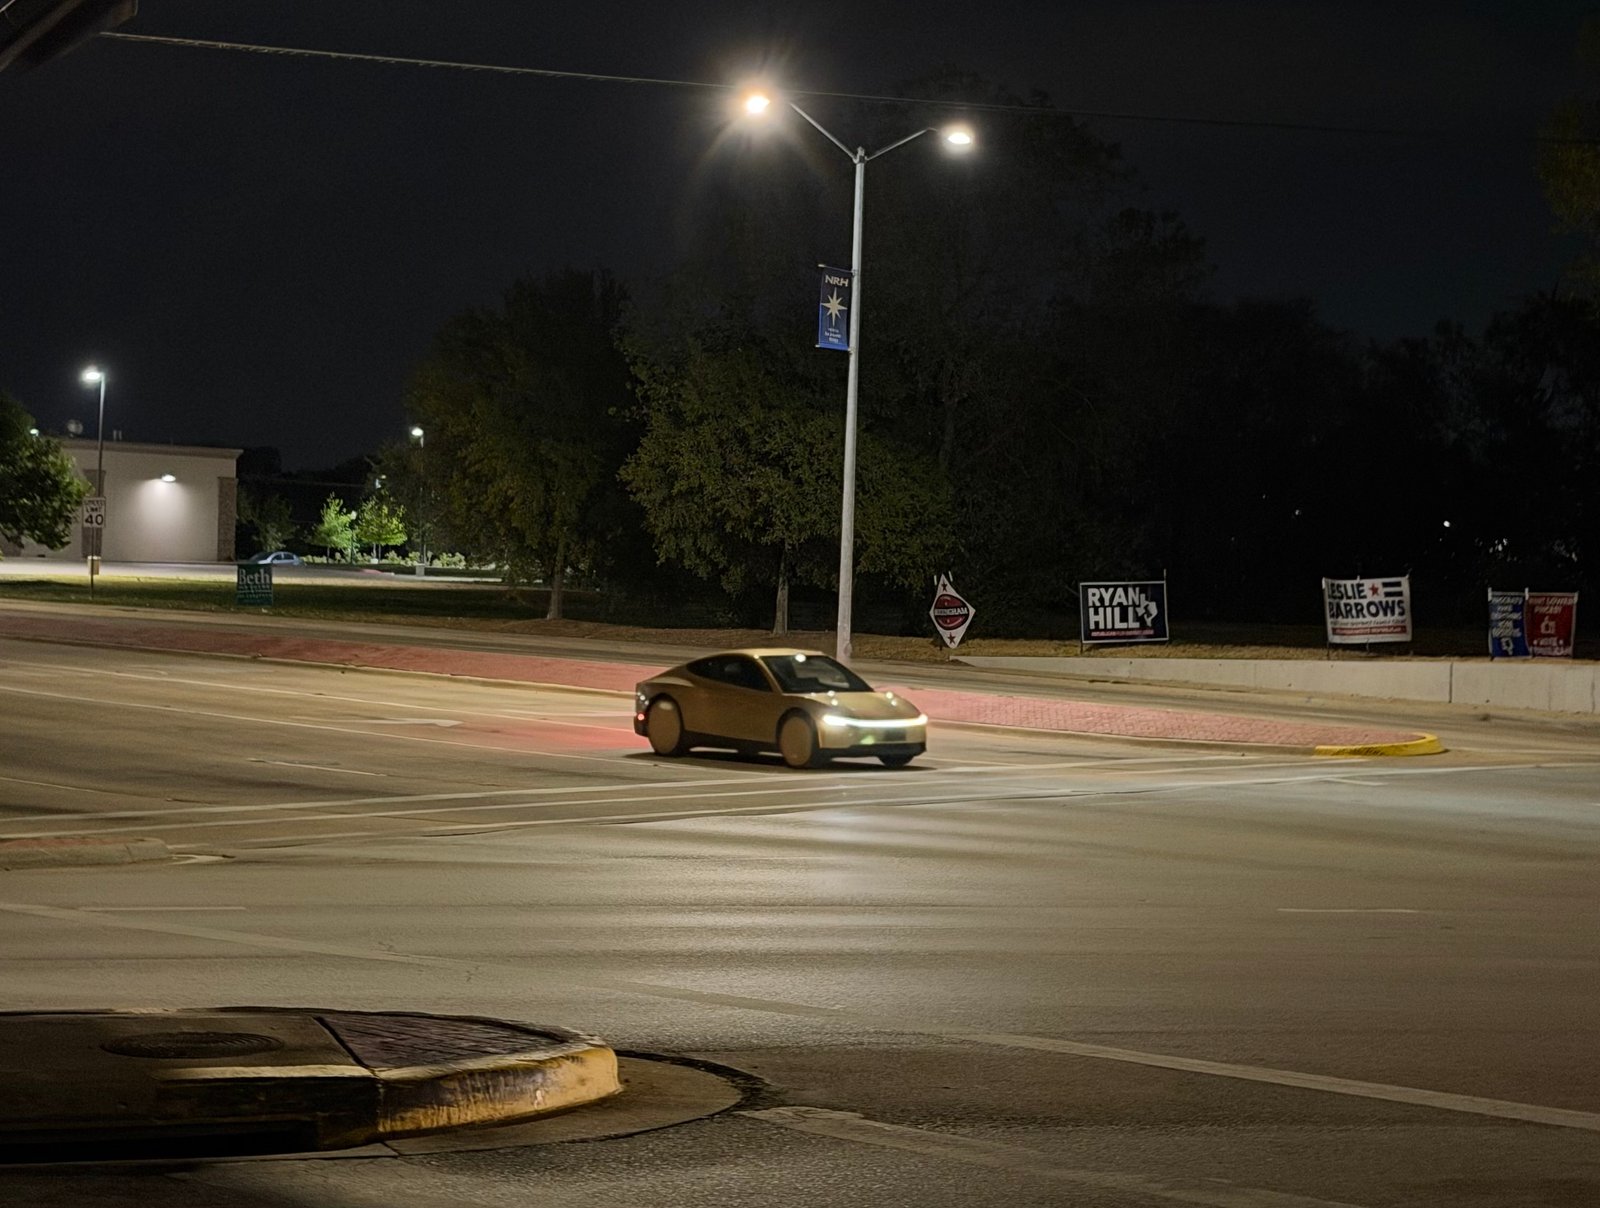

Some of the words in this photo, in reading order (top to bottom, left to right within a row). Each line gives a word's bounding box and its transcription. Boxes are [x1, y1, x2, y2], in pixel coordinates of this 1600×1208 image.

[825, 275, 848, 287] NRH
[85, 514, 104, 526] 40
[239, 568, 271, 585] Beth
[1087, 587, 1140, 607] RYAN
[1088, 606, 1140, 630] HILL
